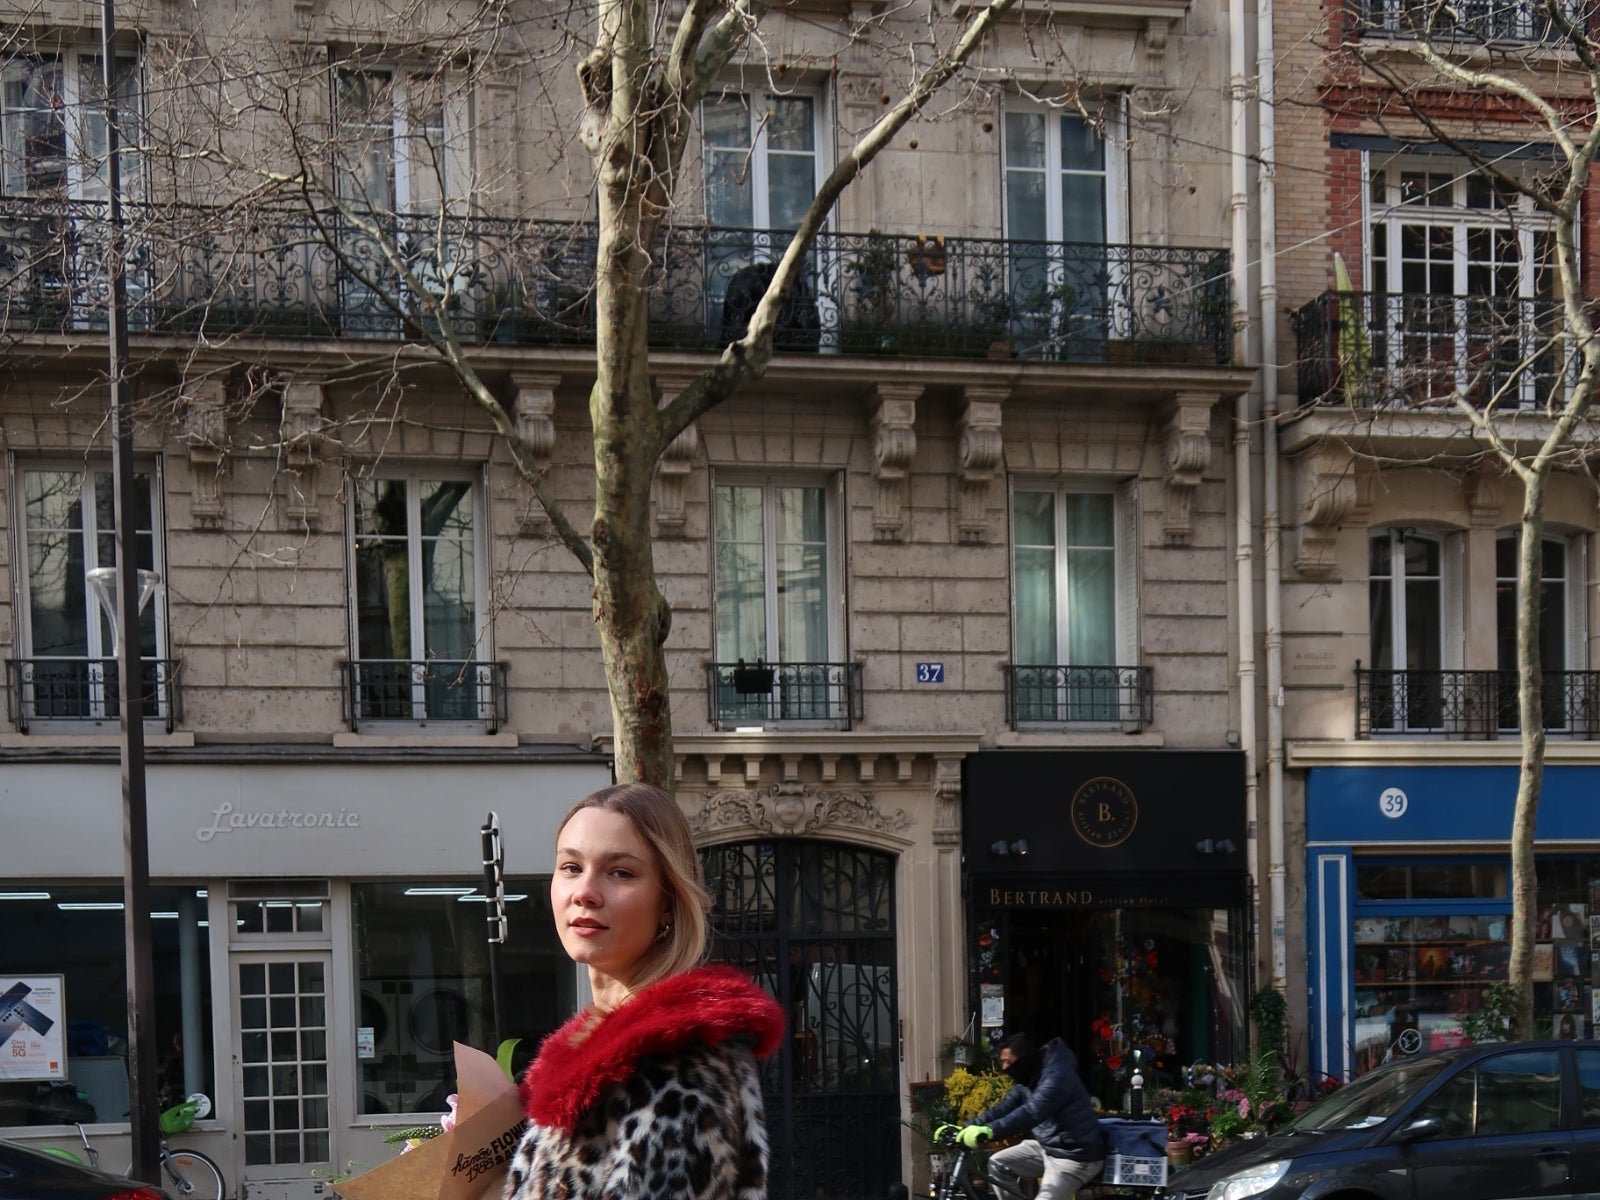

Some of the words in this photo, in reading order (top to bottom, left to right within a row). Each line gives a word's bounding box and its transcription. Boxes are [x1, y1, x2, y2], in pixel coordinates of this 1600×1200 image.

[919, 663, 941, 681] 37
[1097, 802, 1116, 822] B.
[1385, 794, 1403, 813] 39
[194, 800, 361, 842] Lavatronic
[990, 888, 1094, 905] BERTRAND
[12, 1048, 26, 1057] 5G
[465, 1158, 495, 1183] 1988
